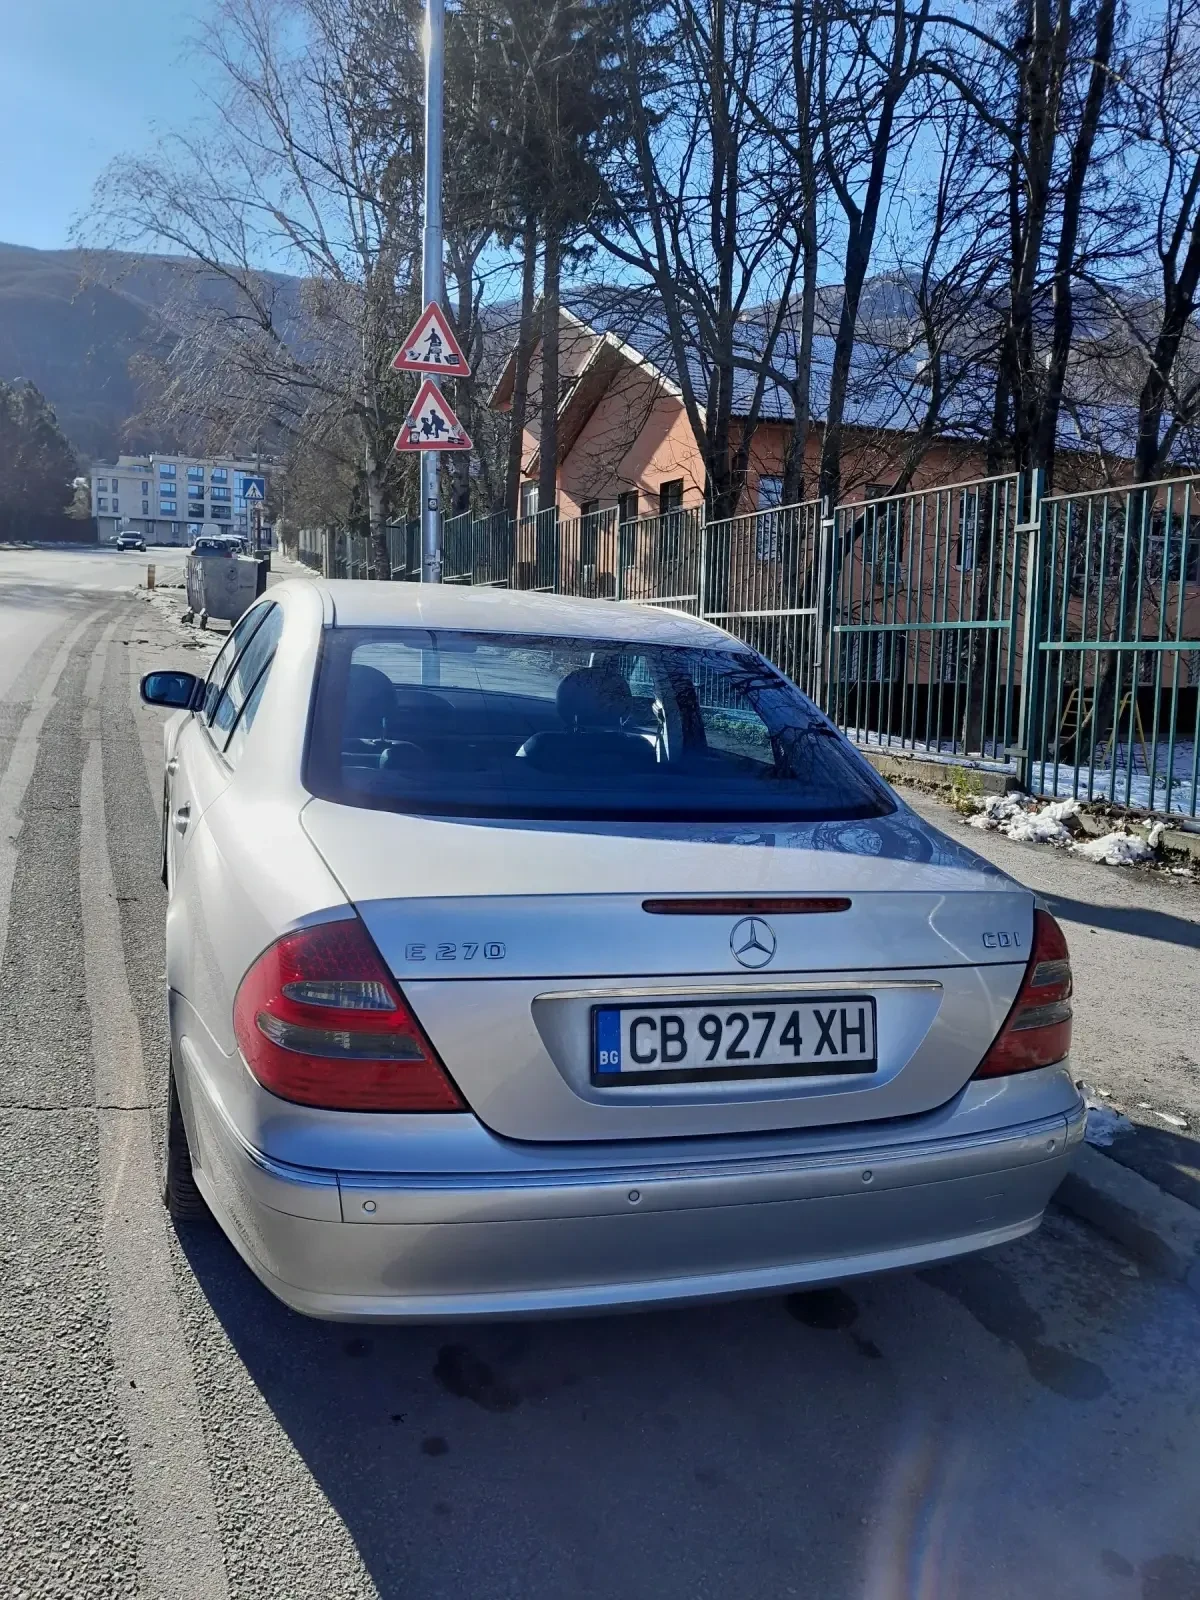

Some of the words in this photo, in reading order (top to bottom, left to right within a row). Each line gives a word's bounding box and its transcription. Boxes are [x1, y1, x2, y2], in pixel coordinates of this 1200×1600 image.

[982, 931, 1021, 948] CDI
[405, 943, 426, 961] E
[435, 941, 506, 961] 270
[629, 1015, 688, 1064] CB
[698, 1010, 803, 1061] 9274
[812, 1008, 866, 1056] XH
[599, 1050, 619, 1065] BG
